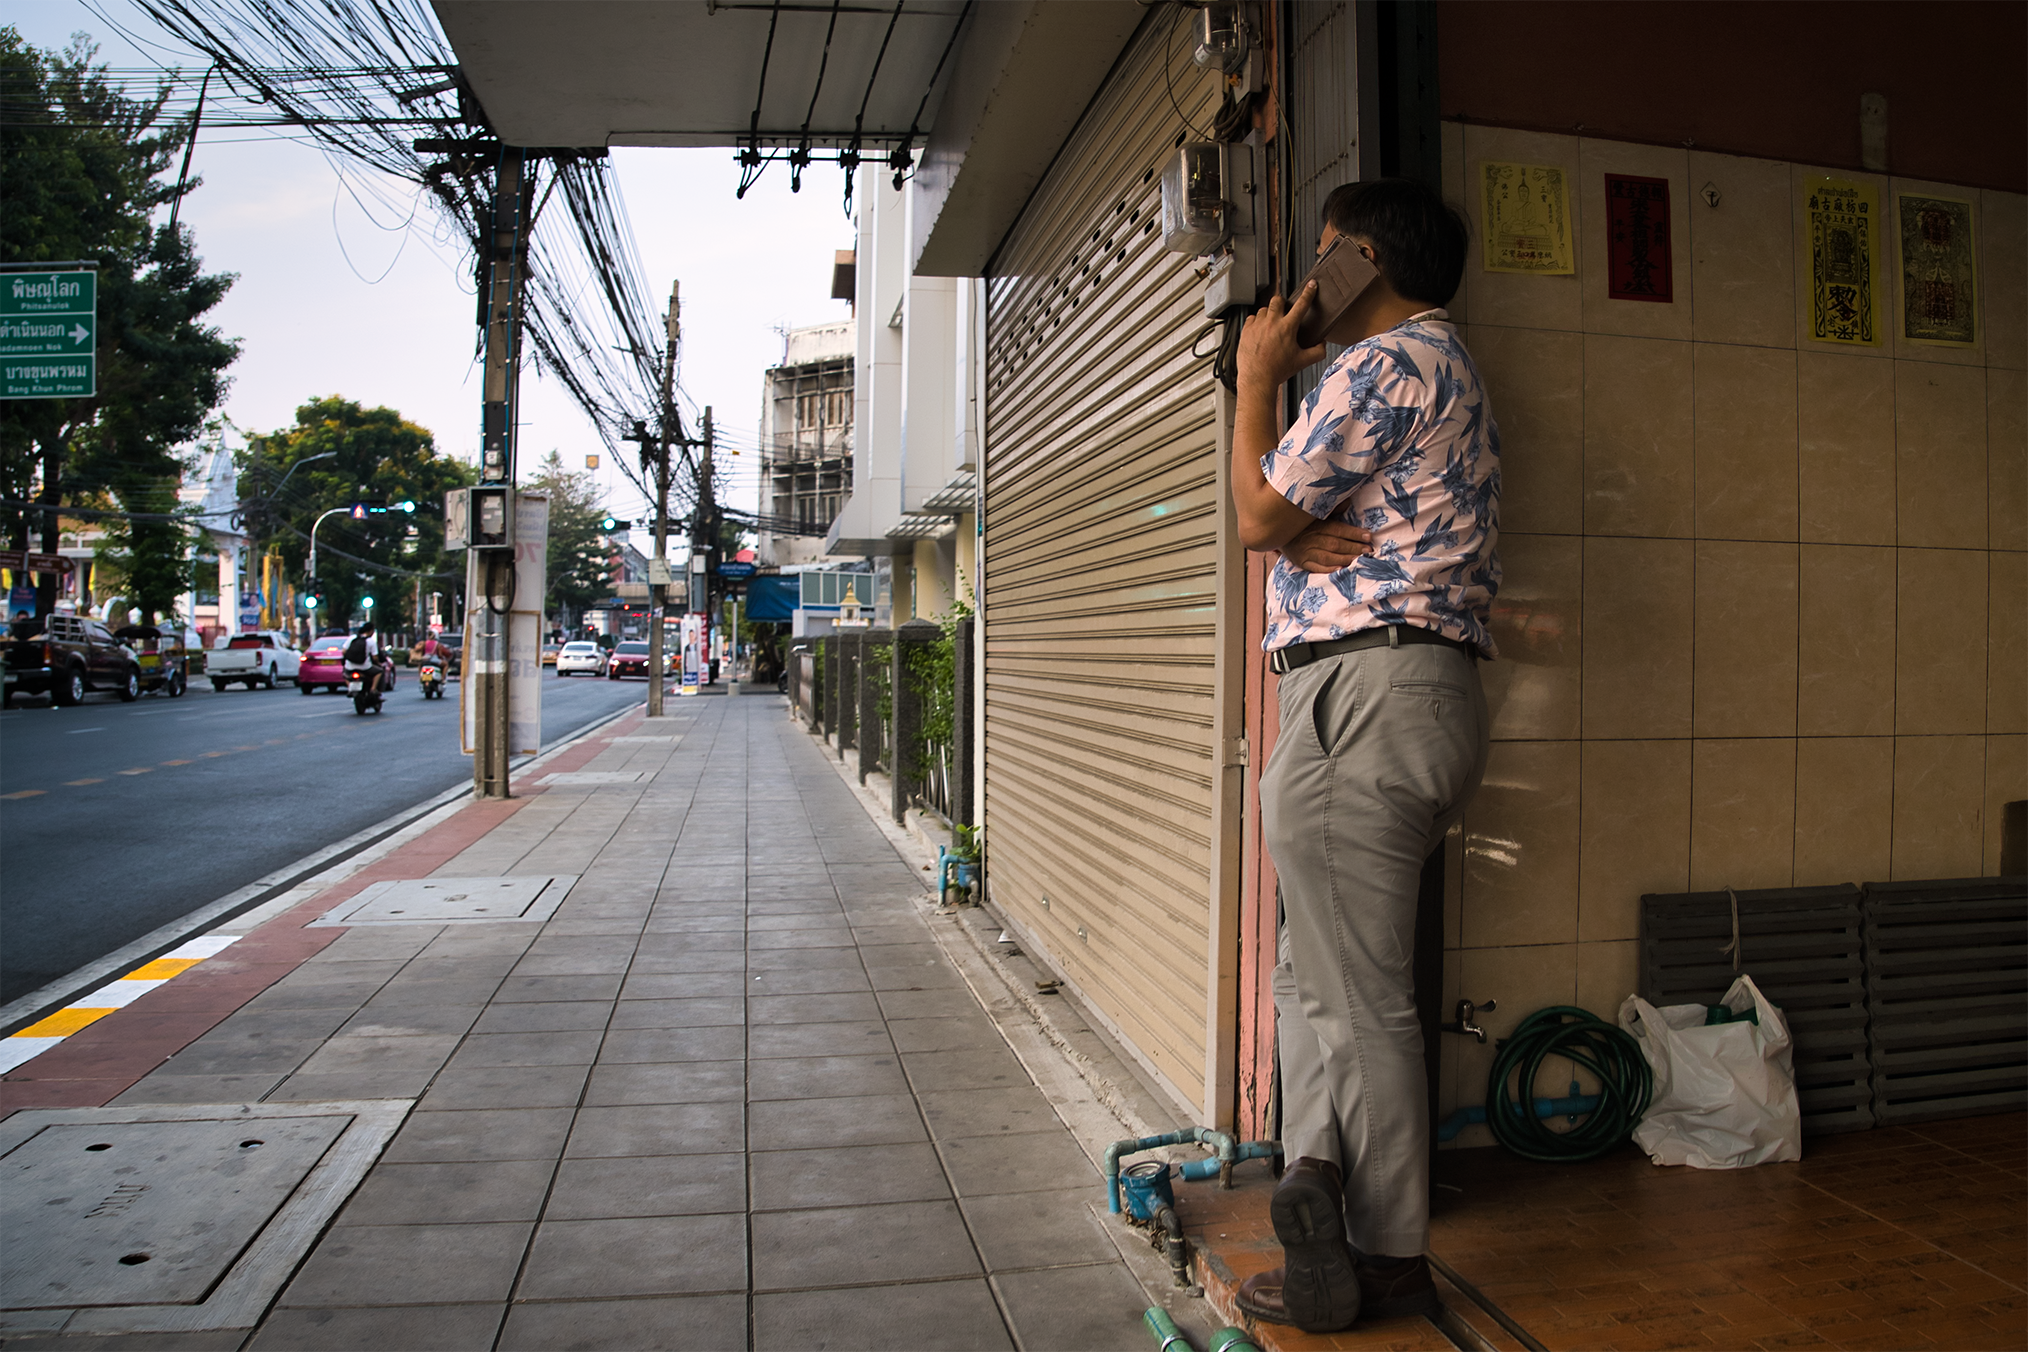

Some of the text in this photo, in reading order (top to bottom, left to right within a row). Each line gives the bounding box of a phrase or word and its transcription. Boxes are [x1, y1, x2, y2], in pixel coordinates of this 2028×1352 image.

[12, 275, 80, 303] พิษณุโลก
[46, 343, 62, 351] Nok
[6, 365, 87, 383] บางขุนพรหม
[8, 385, 29, 394] Bang
